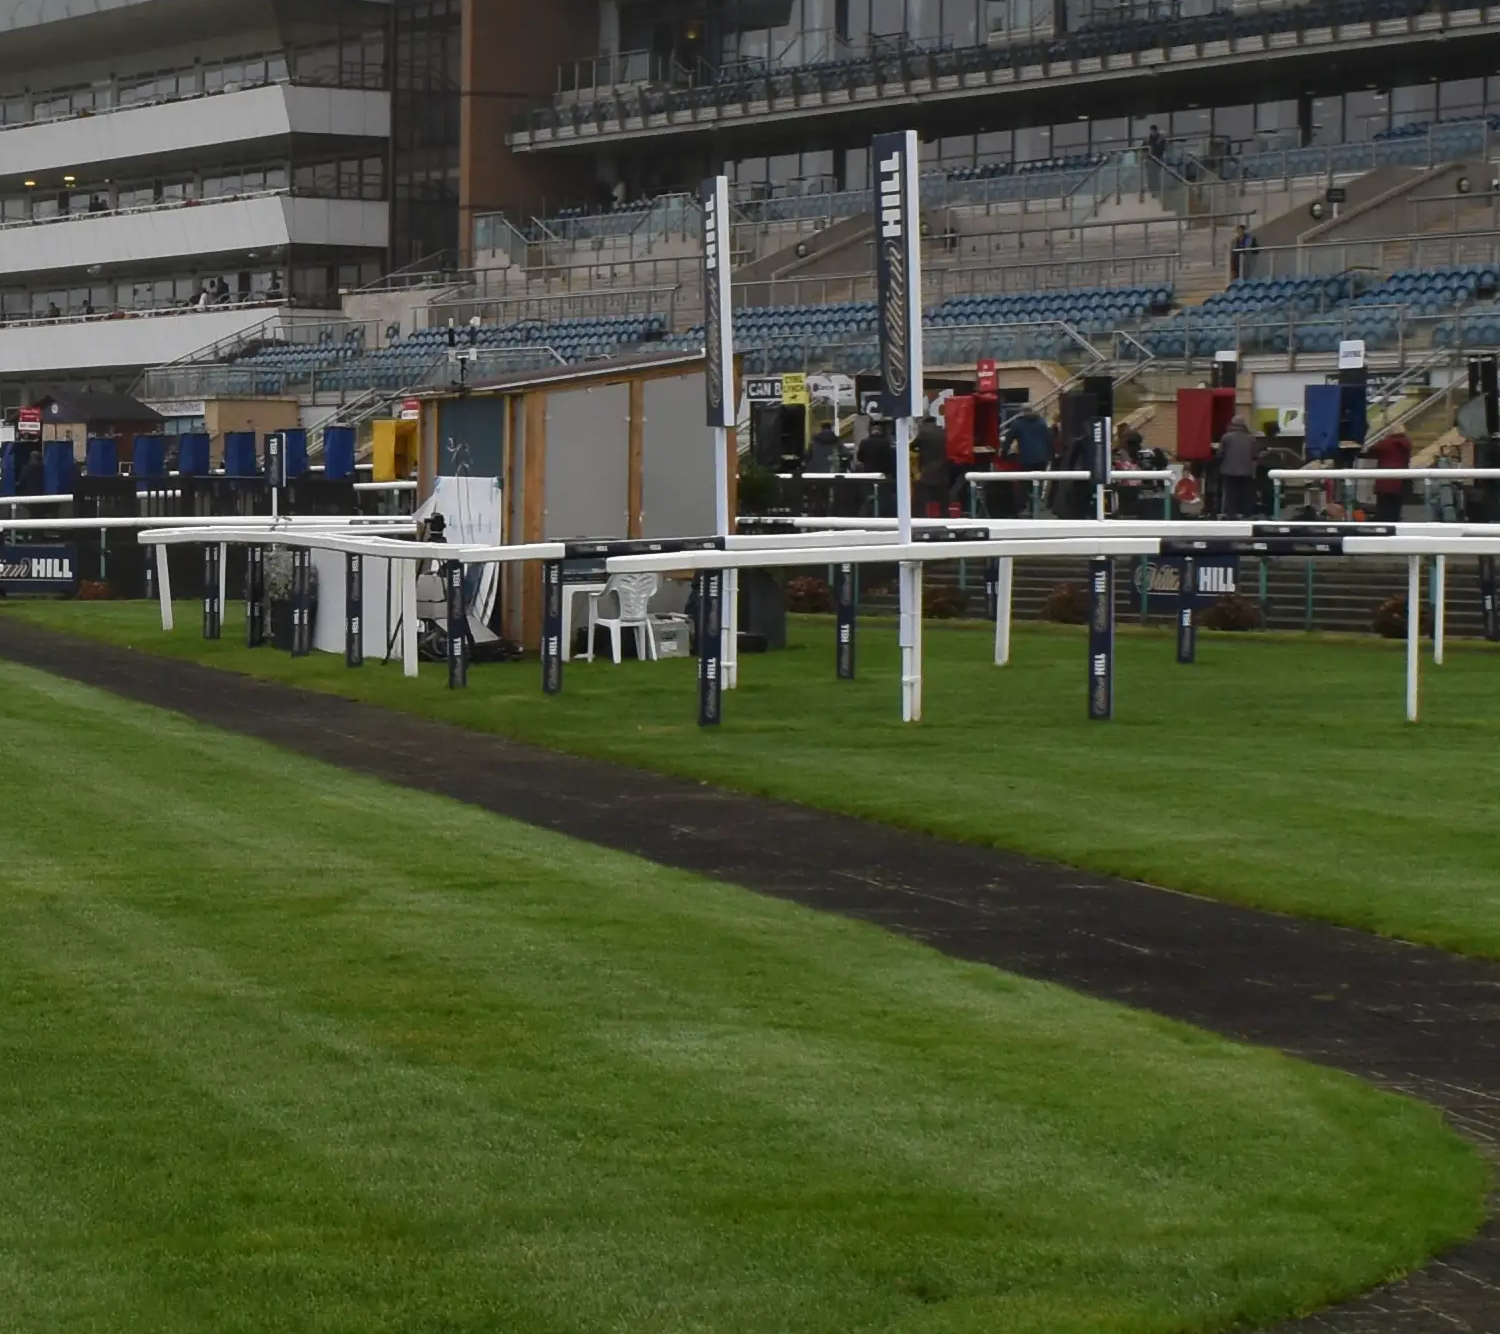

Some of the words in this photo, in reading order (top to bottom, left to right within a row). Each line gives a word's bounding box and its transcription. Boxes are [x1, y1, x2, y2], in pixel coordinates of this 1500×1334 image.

[880, 151, 902, 238] HILL
[705, 193, 716, 270] HILL
[884, 240, 907, 397] William
[749, 382, 772, 396] CAN
[31, 558, 73, 578] HILL
[708, 575, 718, 597] HILL
[1094, 570, 1106, 593] HILL
[1199, 567, 1236, 592] HILL
[707, 657, 717, 679] HILL
[1094, 653, 1106, 675] HILL
